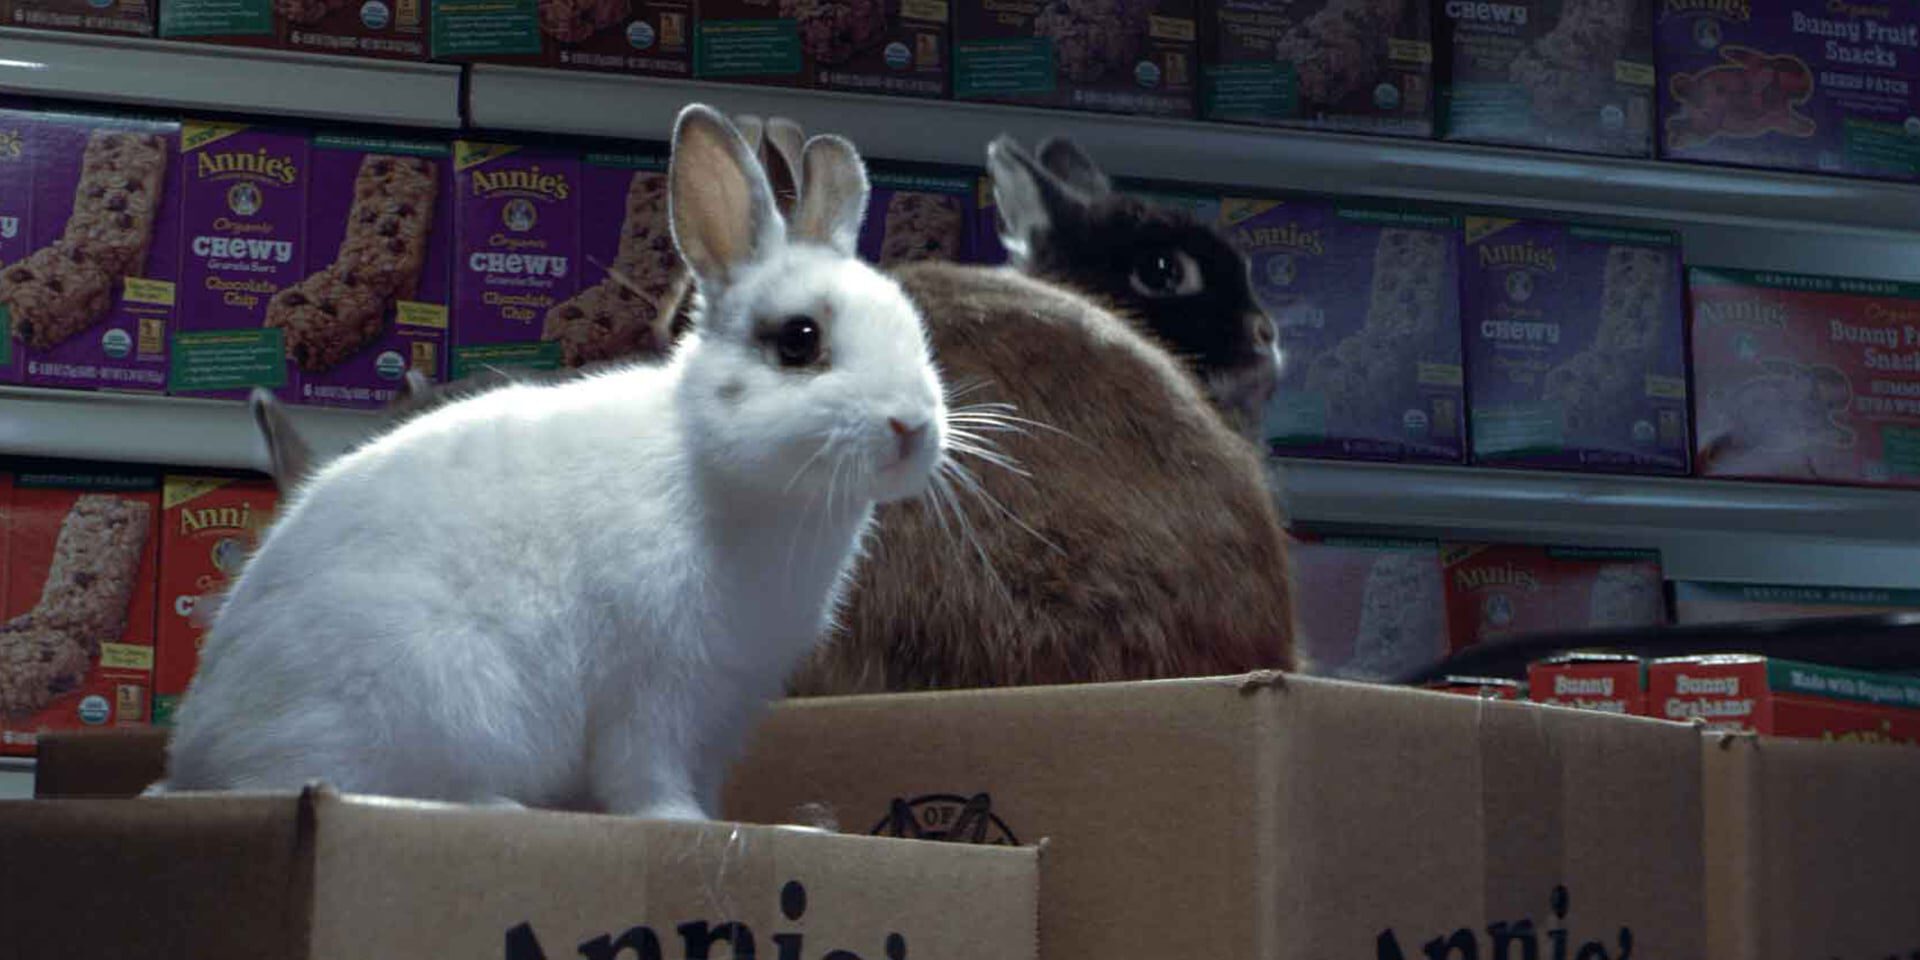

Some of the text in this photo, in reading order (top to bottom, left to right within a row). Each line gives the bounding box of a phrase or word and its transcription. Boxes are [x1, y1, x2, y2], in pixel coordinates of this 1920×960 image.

[1792, 11, 1918, 48] Bunny Fruit
[1825, 40, 1897, 67] Snacks
[197, 148, 297, 184] Annie's
[472, 166, 569, 200] Annie's
[206, 276, 277, 294] Chocolate
[224, 292, 259, 310] Chip
[1829, 320, 1898, 348] Bunny
[1452, 561, 1538, 593] Annie's
[1554, 674, 1615, 697] Bunny
[1675, 674, 1739, 696] Bunny
[1790, 670, 1826, 689] Made
[1828, 676, 1856, 695] with
[1665, 697, 1752, 718] Grahams
[924, 806, 955, 826] OF
